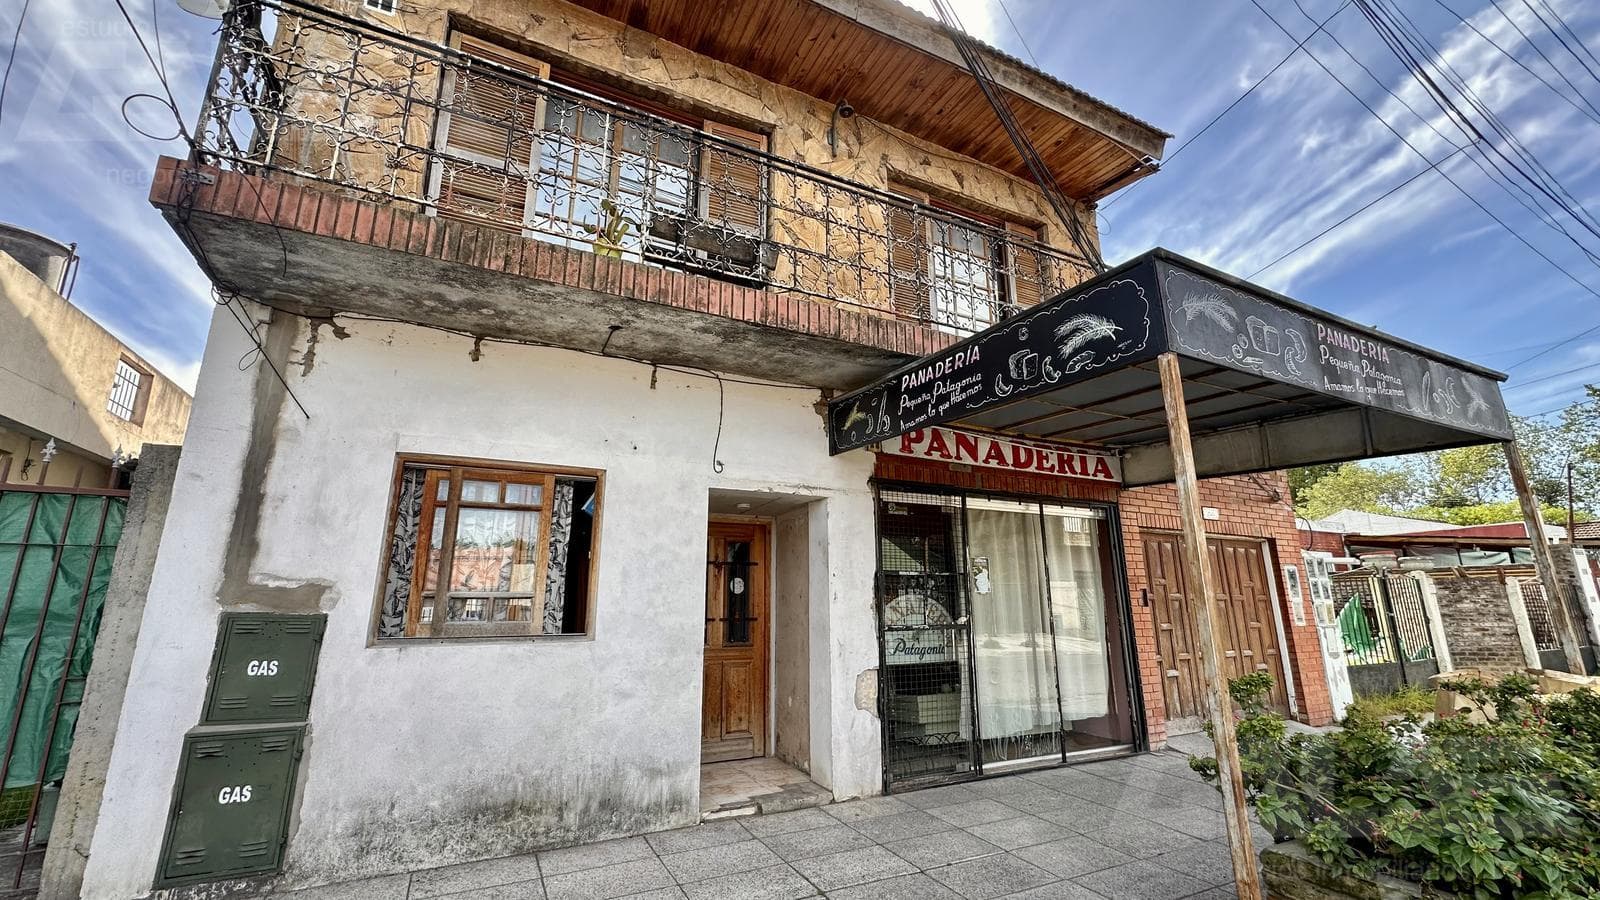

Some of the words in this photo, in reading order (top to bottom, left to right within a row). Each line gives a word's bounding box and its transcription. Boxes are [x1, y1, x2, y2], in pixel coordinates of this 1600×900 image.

[1319, 344, 1360, 375] Pequeña
[1361, 359, 1403, 388] Patagonia
[898, 394, 931, 415] Pequeña
[931, 373, 982, 404] Patagonia
[900, 414, 928, 432] Amamos
[928, 403, 936, 417] lo
[938, 401, 950, 416] que
[950, 383, 982, 405] Hacemos
[1324, 375, 1355, 393] Amamos
[1356, 378, 1364, 393] lo
[1364, 386, 1377, 403] que
[898, 427, 1114, 479] PANADERIA
[247, 660, 279, 676] GAS
[218, 785, 252, 804] GAS
